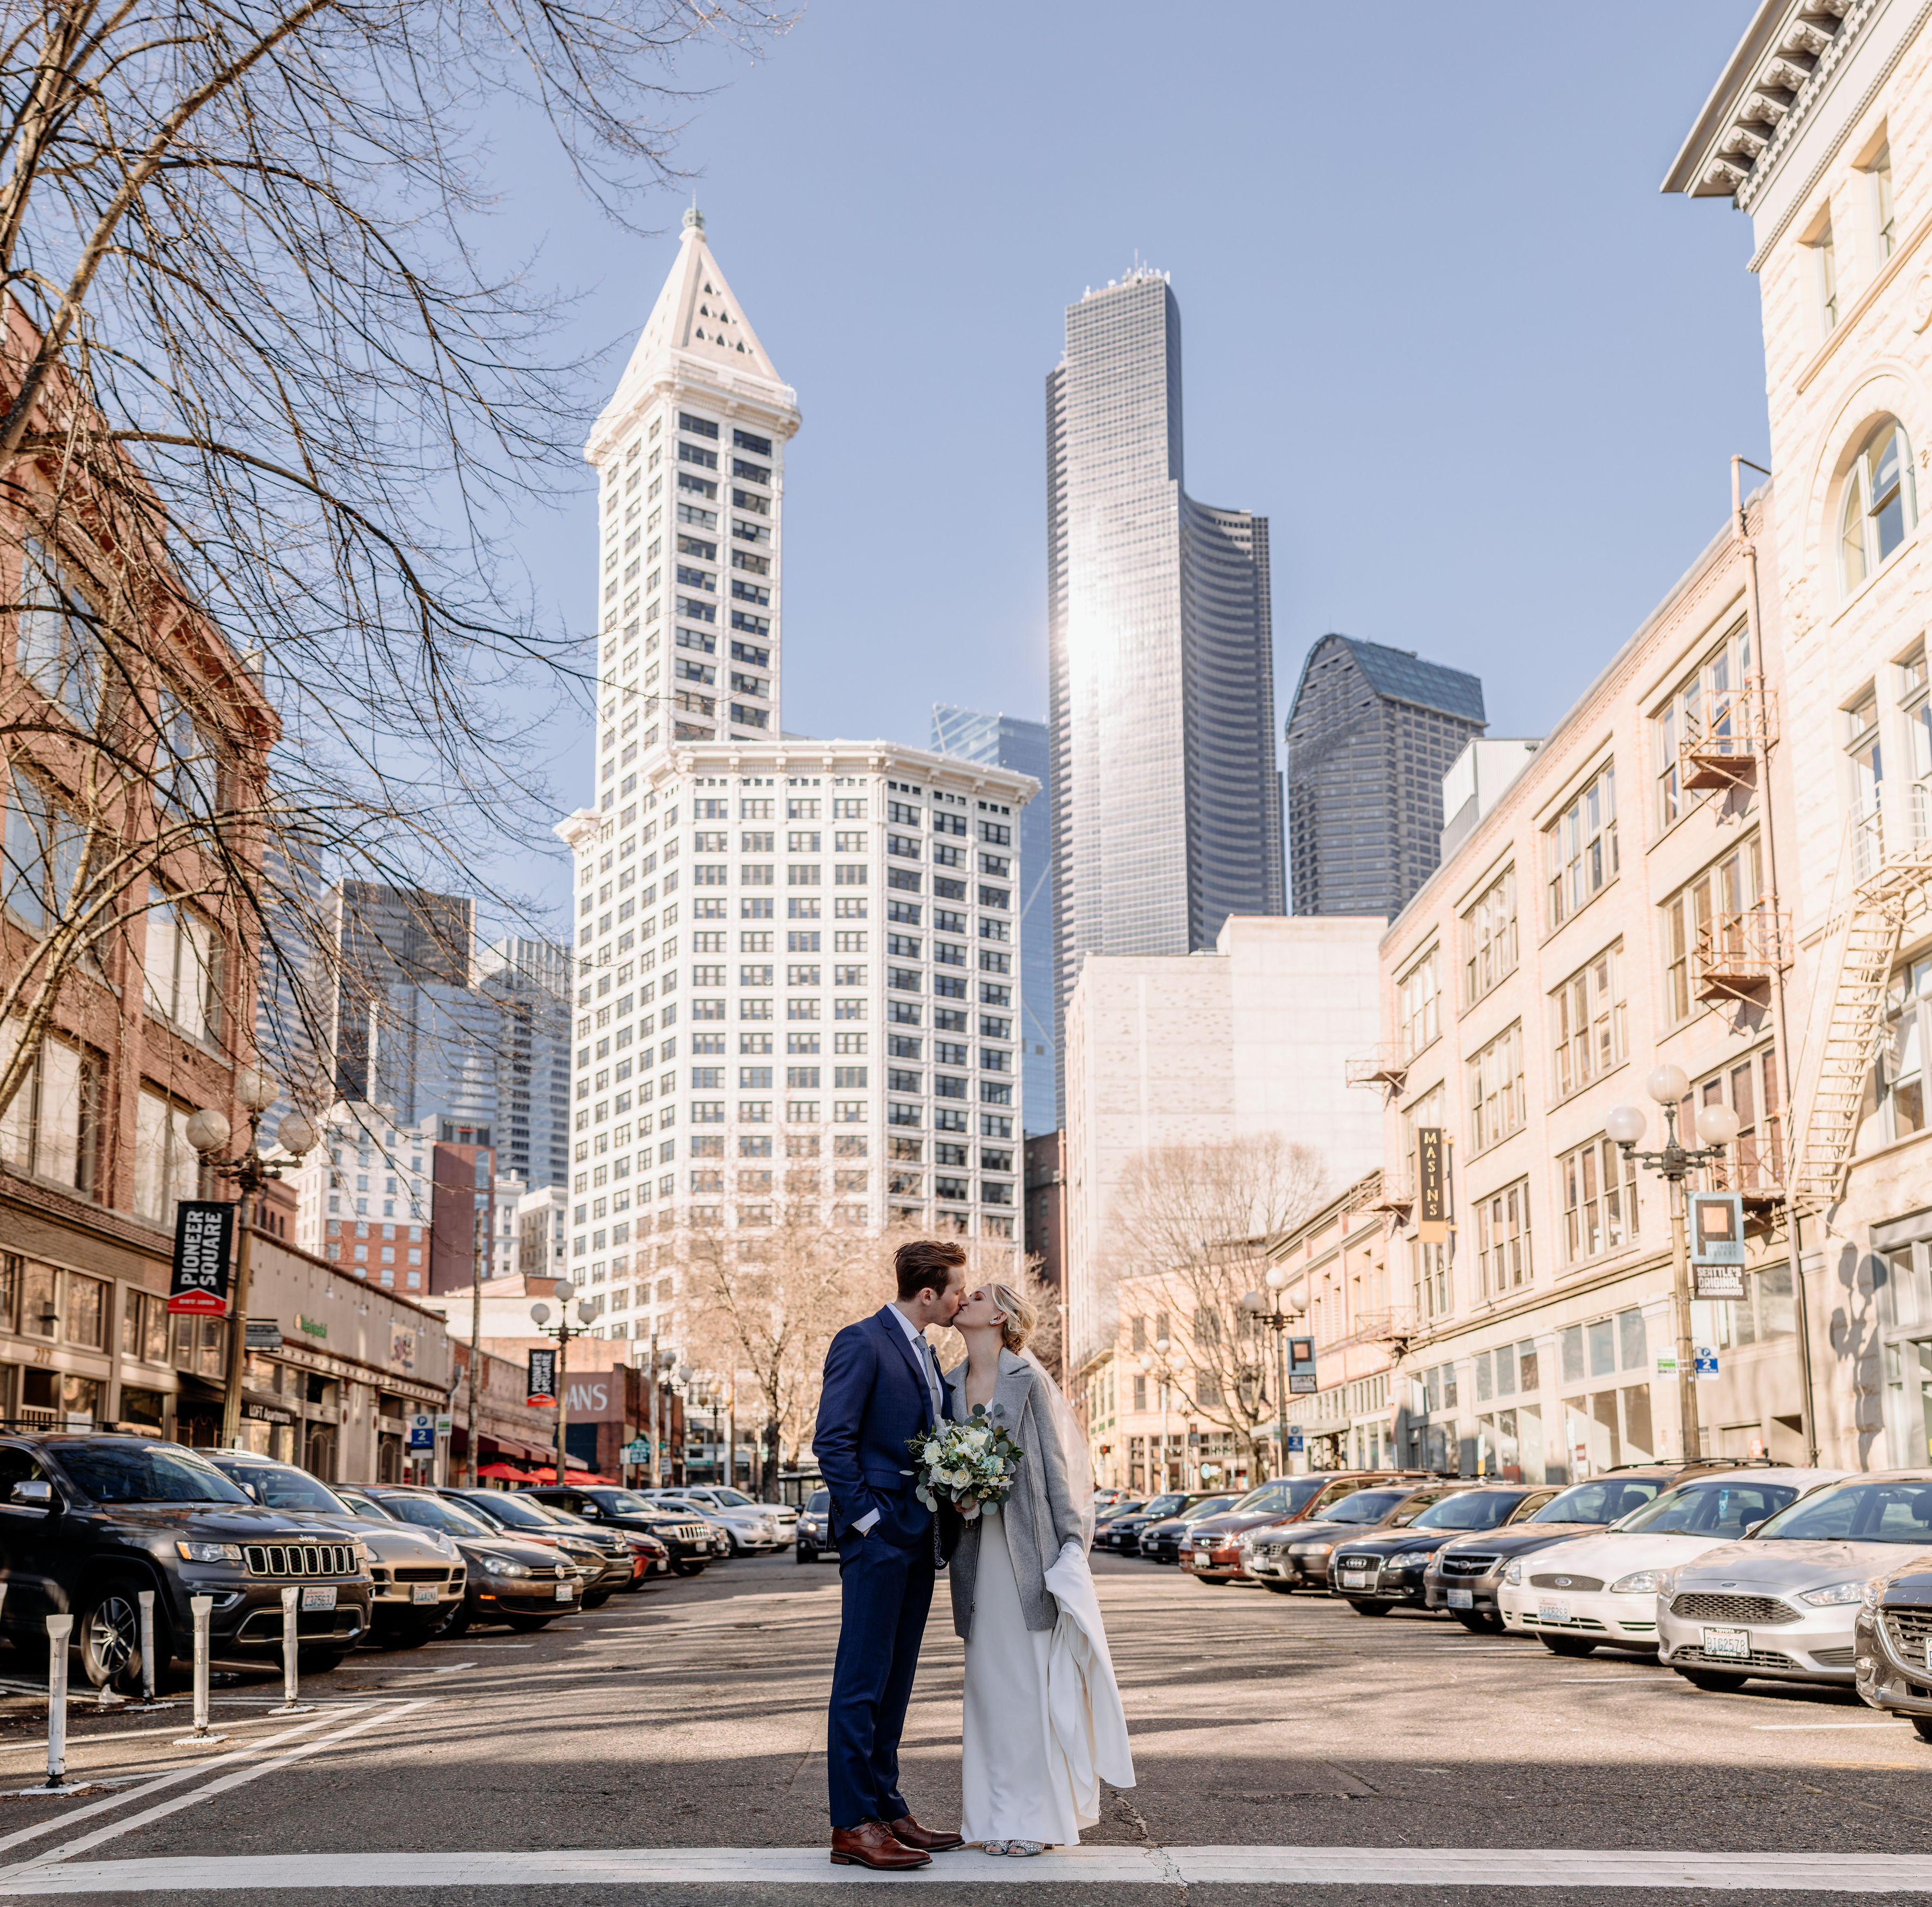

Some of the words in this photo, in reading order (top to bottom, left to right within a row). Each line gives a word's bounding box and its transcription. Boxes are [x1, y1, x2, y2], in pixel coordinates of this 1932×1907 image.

[1424, 1131, 1439, 1216] MASINS
[180, 1210, 204, 1285] PIONEER
[199, 1212, 222, 1286] SQUARE
[1697, 1267, 1741, 1277] SEATTLE'S
[1698, 1276, 1743, 1289] ORIGINAL
[34, 1346, 52, 1364] 217
[1702, 1358, 1711, 1369] 2
[531, 1353, 543, 1392] PIONEER
[541, 1353, 552, 1392] SQUARE
[249, 1404, 264, 1419] LOFT
[264, 1406, 291, 1424] Apartments
[418, 1430, 426, 1441] 2
[1292, 1437, 1299, 1445] 2
[298, 1534, 318, 1543] Jeep
[1707, 1637, 1745, 1653] BIG2578
